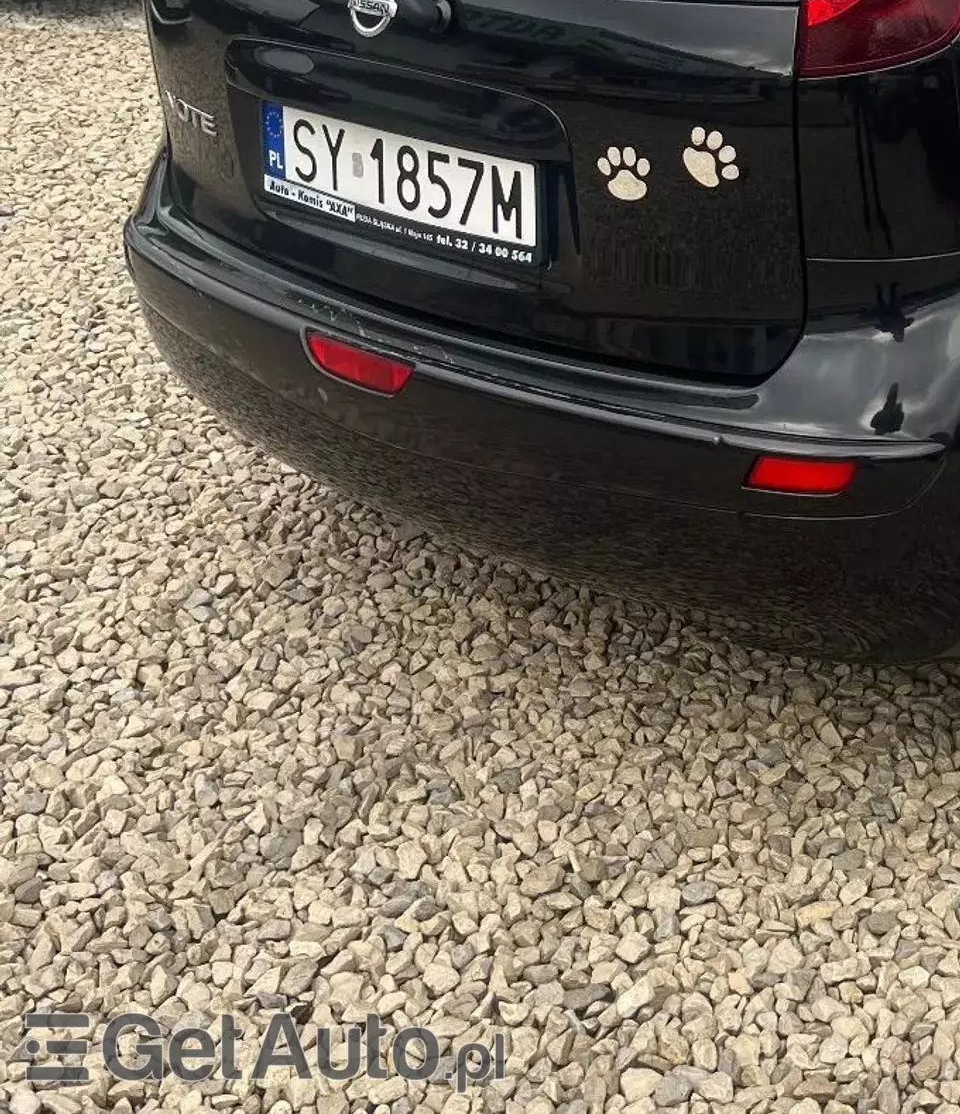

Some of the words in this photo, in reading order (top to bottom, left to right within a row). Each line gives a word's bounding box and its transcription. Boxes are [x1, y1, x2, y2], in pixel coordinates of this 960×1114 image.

[268, 149, 284, 169] PL
[293, 118, 345, 191] SY
[370, 138, 522, 240] 1857M
[269, 180, 290, 196] Auto
[297, 189, 324, 209] Komis
[436, 234, 453, 247] tel.
[454, 238, 469, 250] 32
[478, 243, 493, 255] 34
[495, 246, 509, 259] 00
[511, 249, 532, 263] 564
